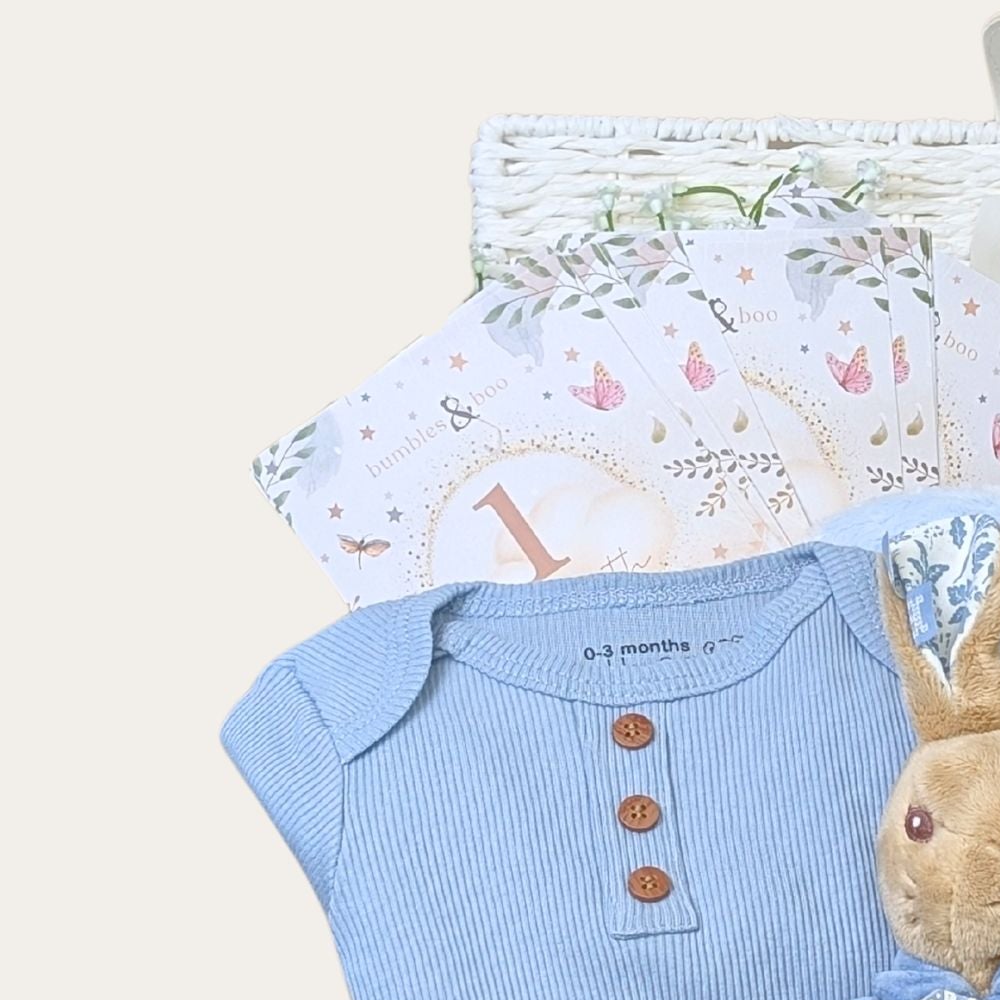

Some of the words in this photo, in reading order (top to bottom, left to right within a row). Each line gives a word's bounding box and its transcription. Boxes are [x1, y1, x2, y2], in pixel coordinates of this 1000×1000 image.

[738, 306, 779, 325] boo
[943, 329, 979, 362] boo
[364, 417, 449, 479] bumbles
[468, 380, 509, 407] boo
[472, 482, 572, 582] 1
[583, 644, 614, 662] 0-3
[620, 639, 691, 656] months
